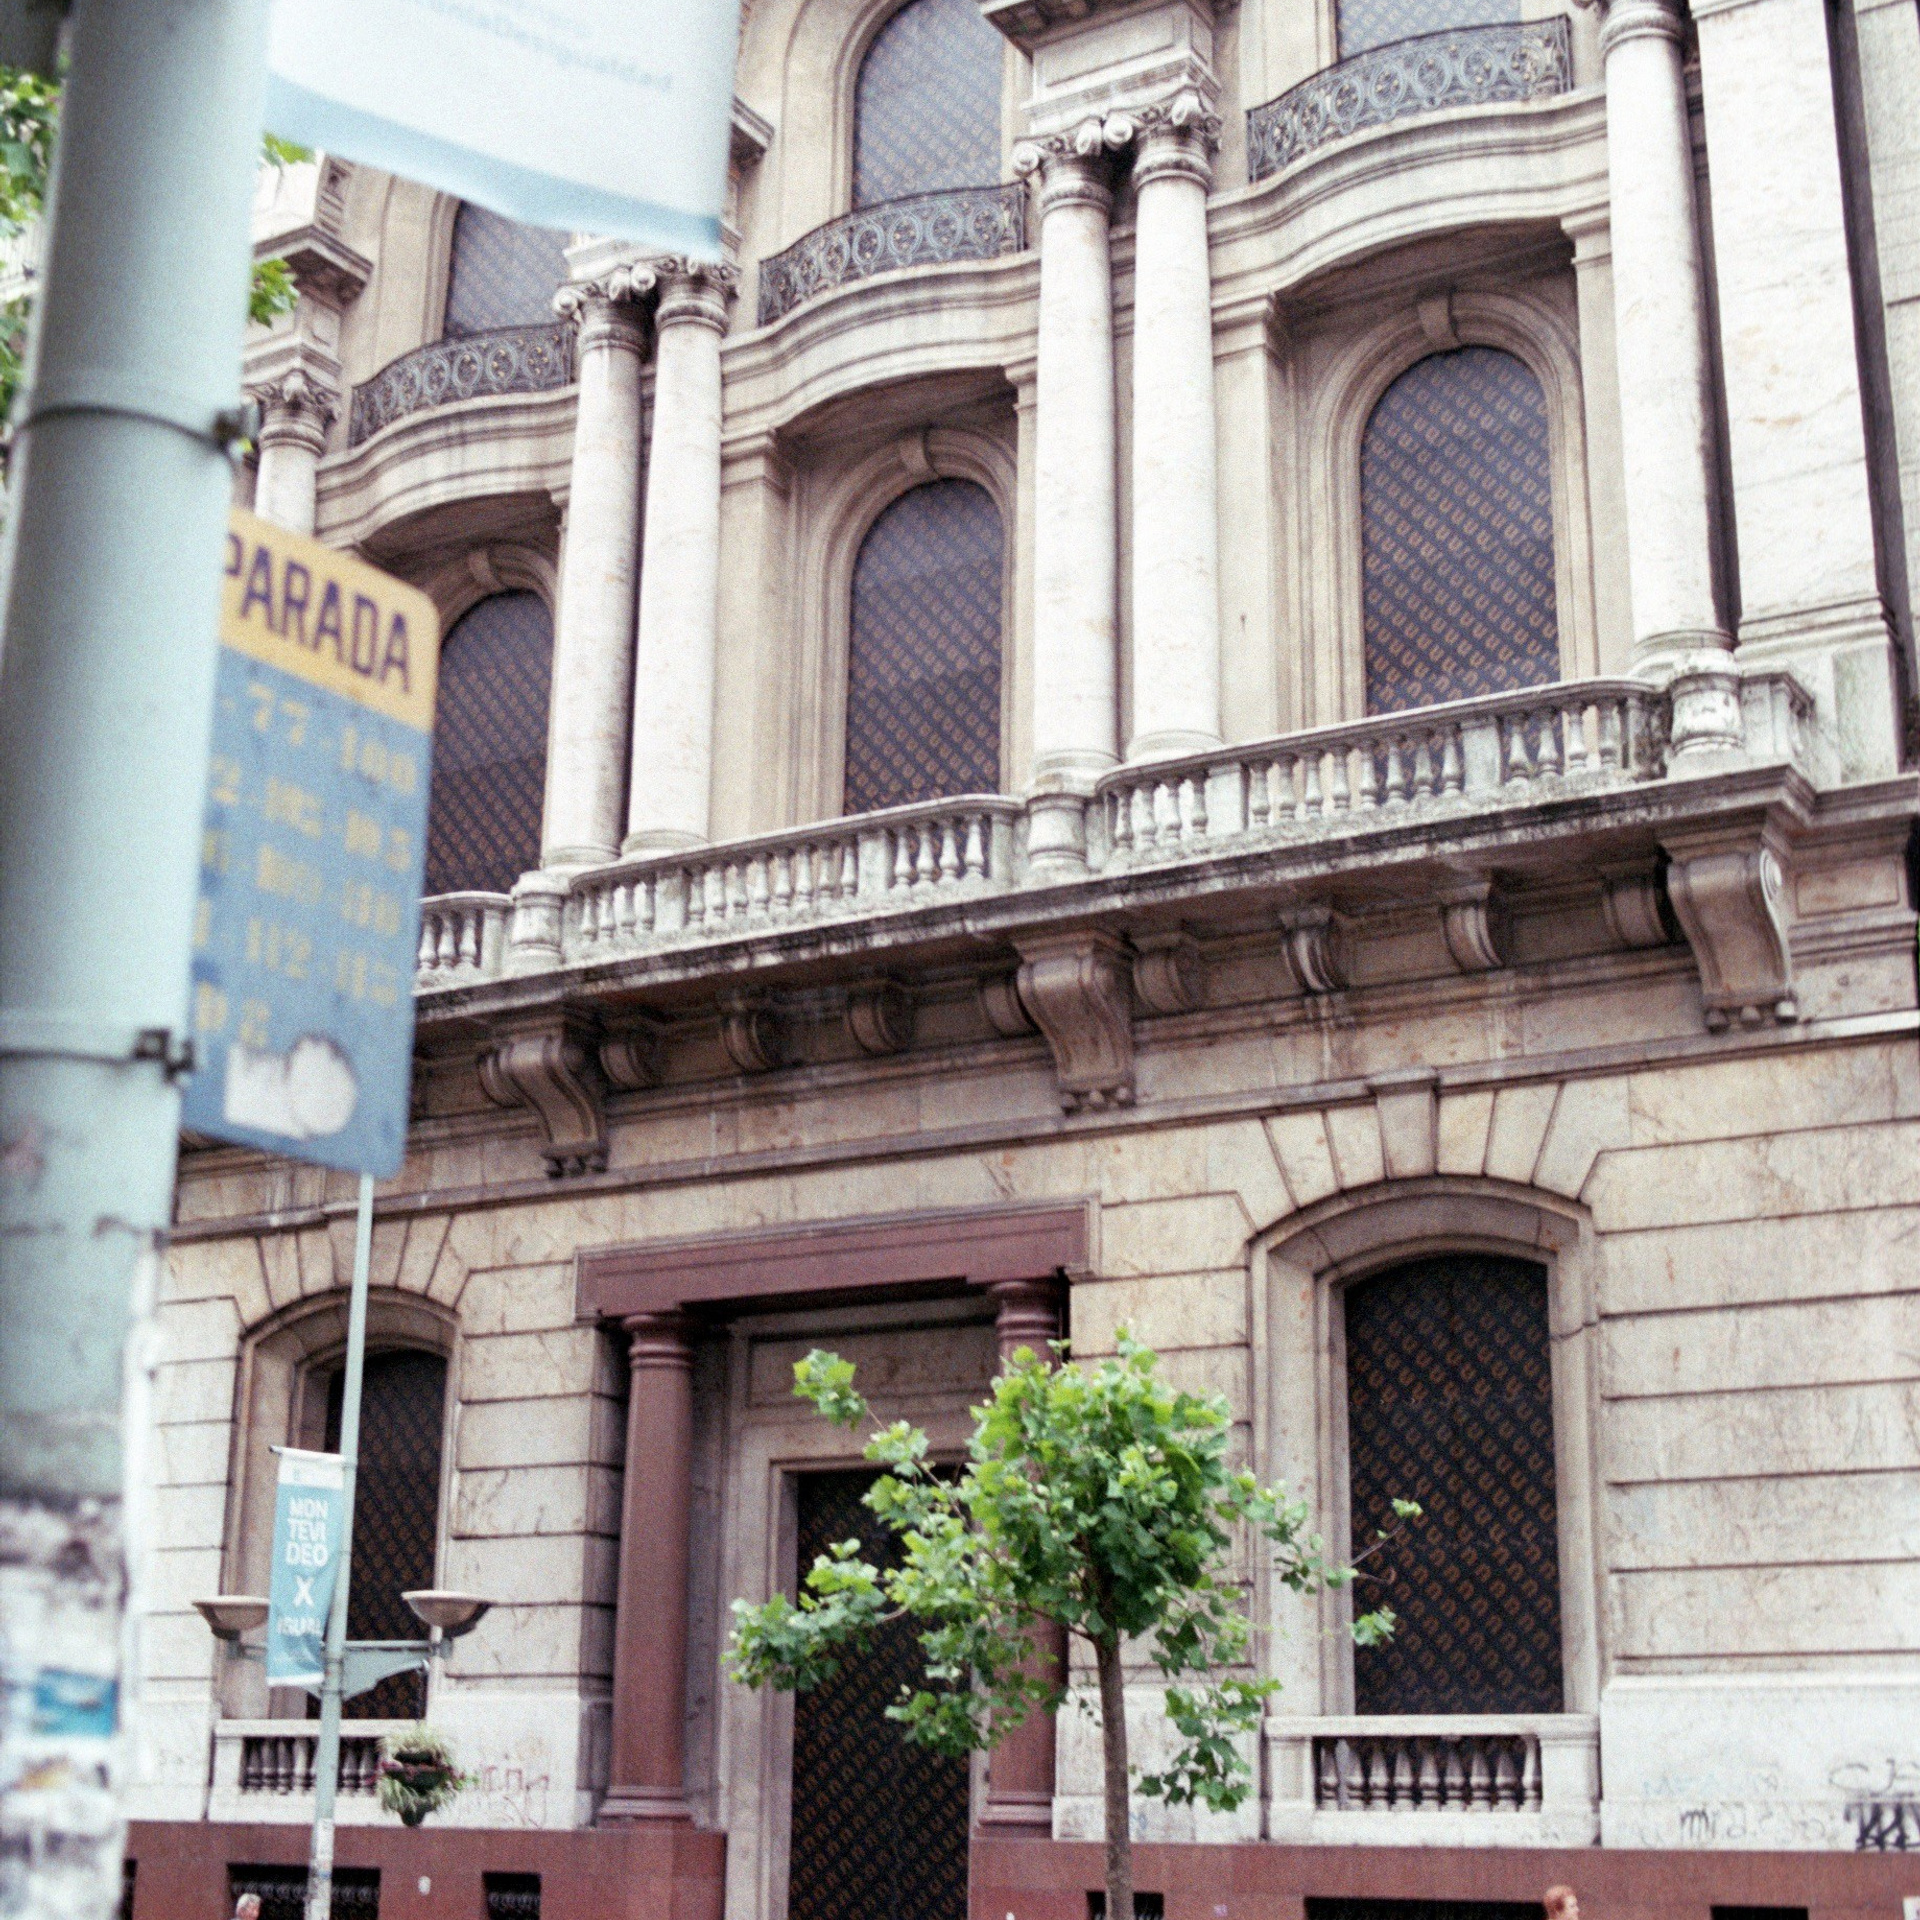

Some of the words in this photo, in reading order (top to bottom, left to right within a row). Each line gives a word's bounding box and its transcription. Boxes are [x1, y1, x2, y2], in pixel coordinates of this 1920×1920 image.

[289, 1497, 329, 1520] MON
[286, 1518, 327, 1543] TEVI
[285, 1541, 329, 1568] DEO
